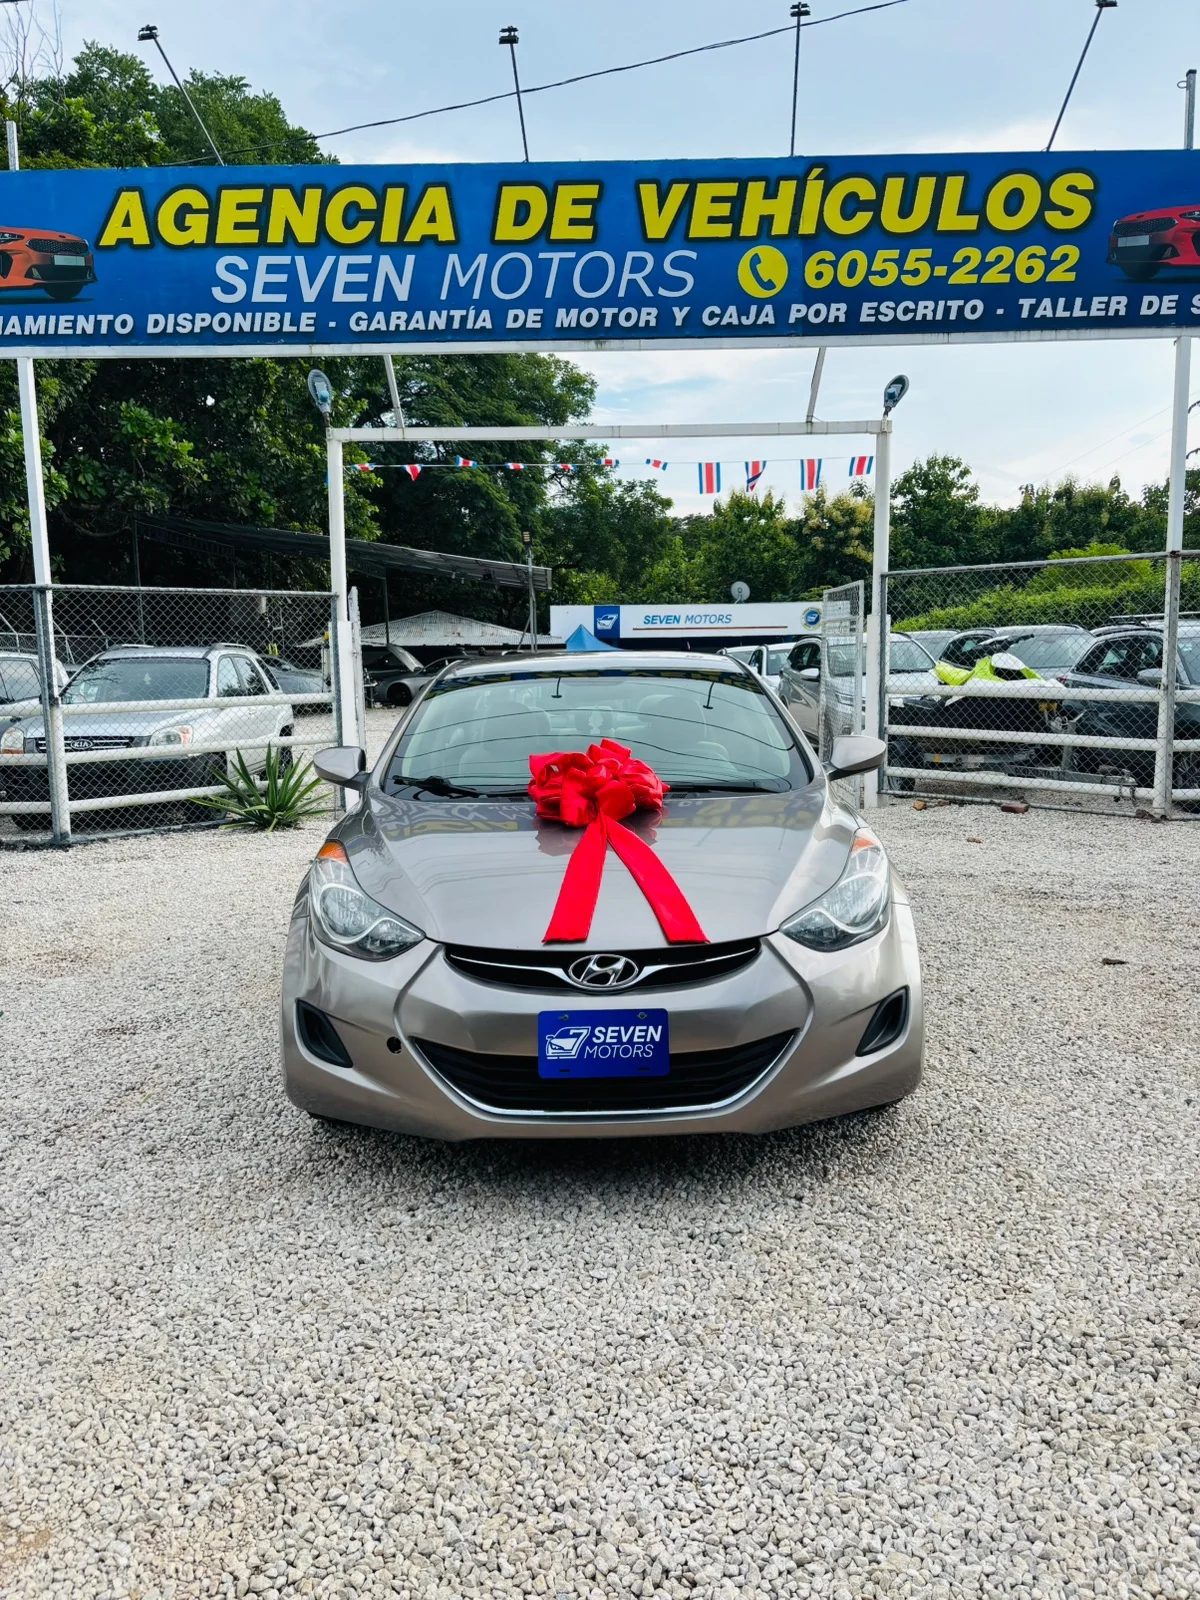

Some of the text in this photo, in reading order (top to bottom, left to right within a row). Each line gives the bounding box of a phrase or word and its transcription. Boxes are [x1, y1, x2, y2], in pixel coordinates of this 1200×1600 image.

[99, 167, 1095, 246] AGENCIA DE VEHÍCULOS
[211, 250, 697, 303] SEVEN MOTORS
[804, 245, 1080, 289] 6055-2262
[0, 313, 134, 335] AMIENTO
[147, 312, 317, 334] DISPONIBLE
[349, 305, 492, 332] GARANTÍA
[506, 308, 544, 329] DE
[555, 307, 658, 328] MOTOR
[672, 306, 690, 326] Y
[702, 304, 775, 326] CAJA
[788, 303, 847, 324] POR
[859, 299, 984, 322] ESCRITO
[1018, 295, 1128, 318] TALLER
[1139, 294, 1179, 315] DE
[643, 614, 733, 625] SEVEN MOTORS
[584, 1044, 654, 1059] MOTORS
[592, 1025, 662, 1043] SEVEN
